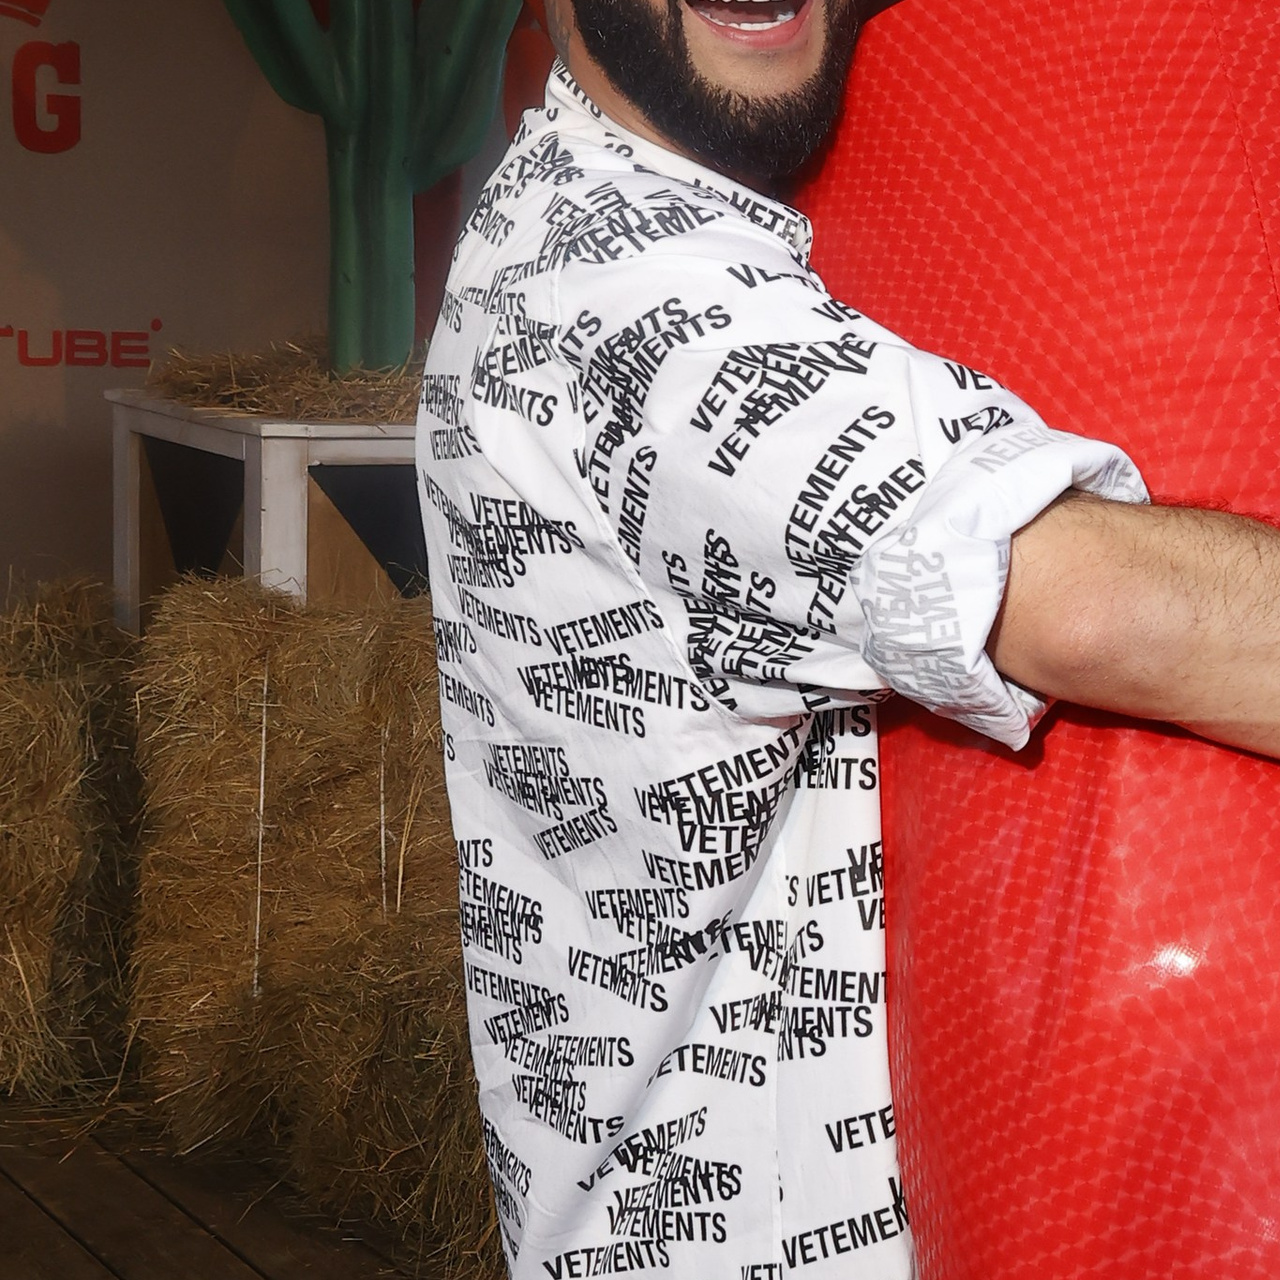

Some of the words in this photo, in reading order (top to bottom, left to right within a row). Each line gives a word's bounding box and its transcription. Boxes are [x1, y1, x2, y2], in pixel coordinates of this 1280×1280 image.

[12, 40, 81, 154] G
[0, 327, 150, 368] UBE
[457, 584, 542, 647] VETEMENTS
[543, 599, 665, 657] VETEMENTS
